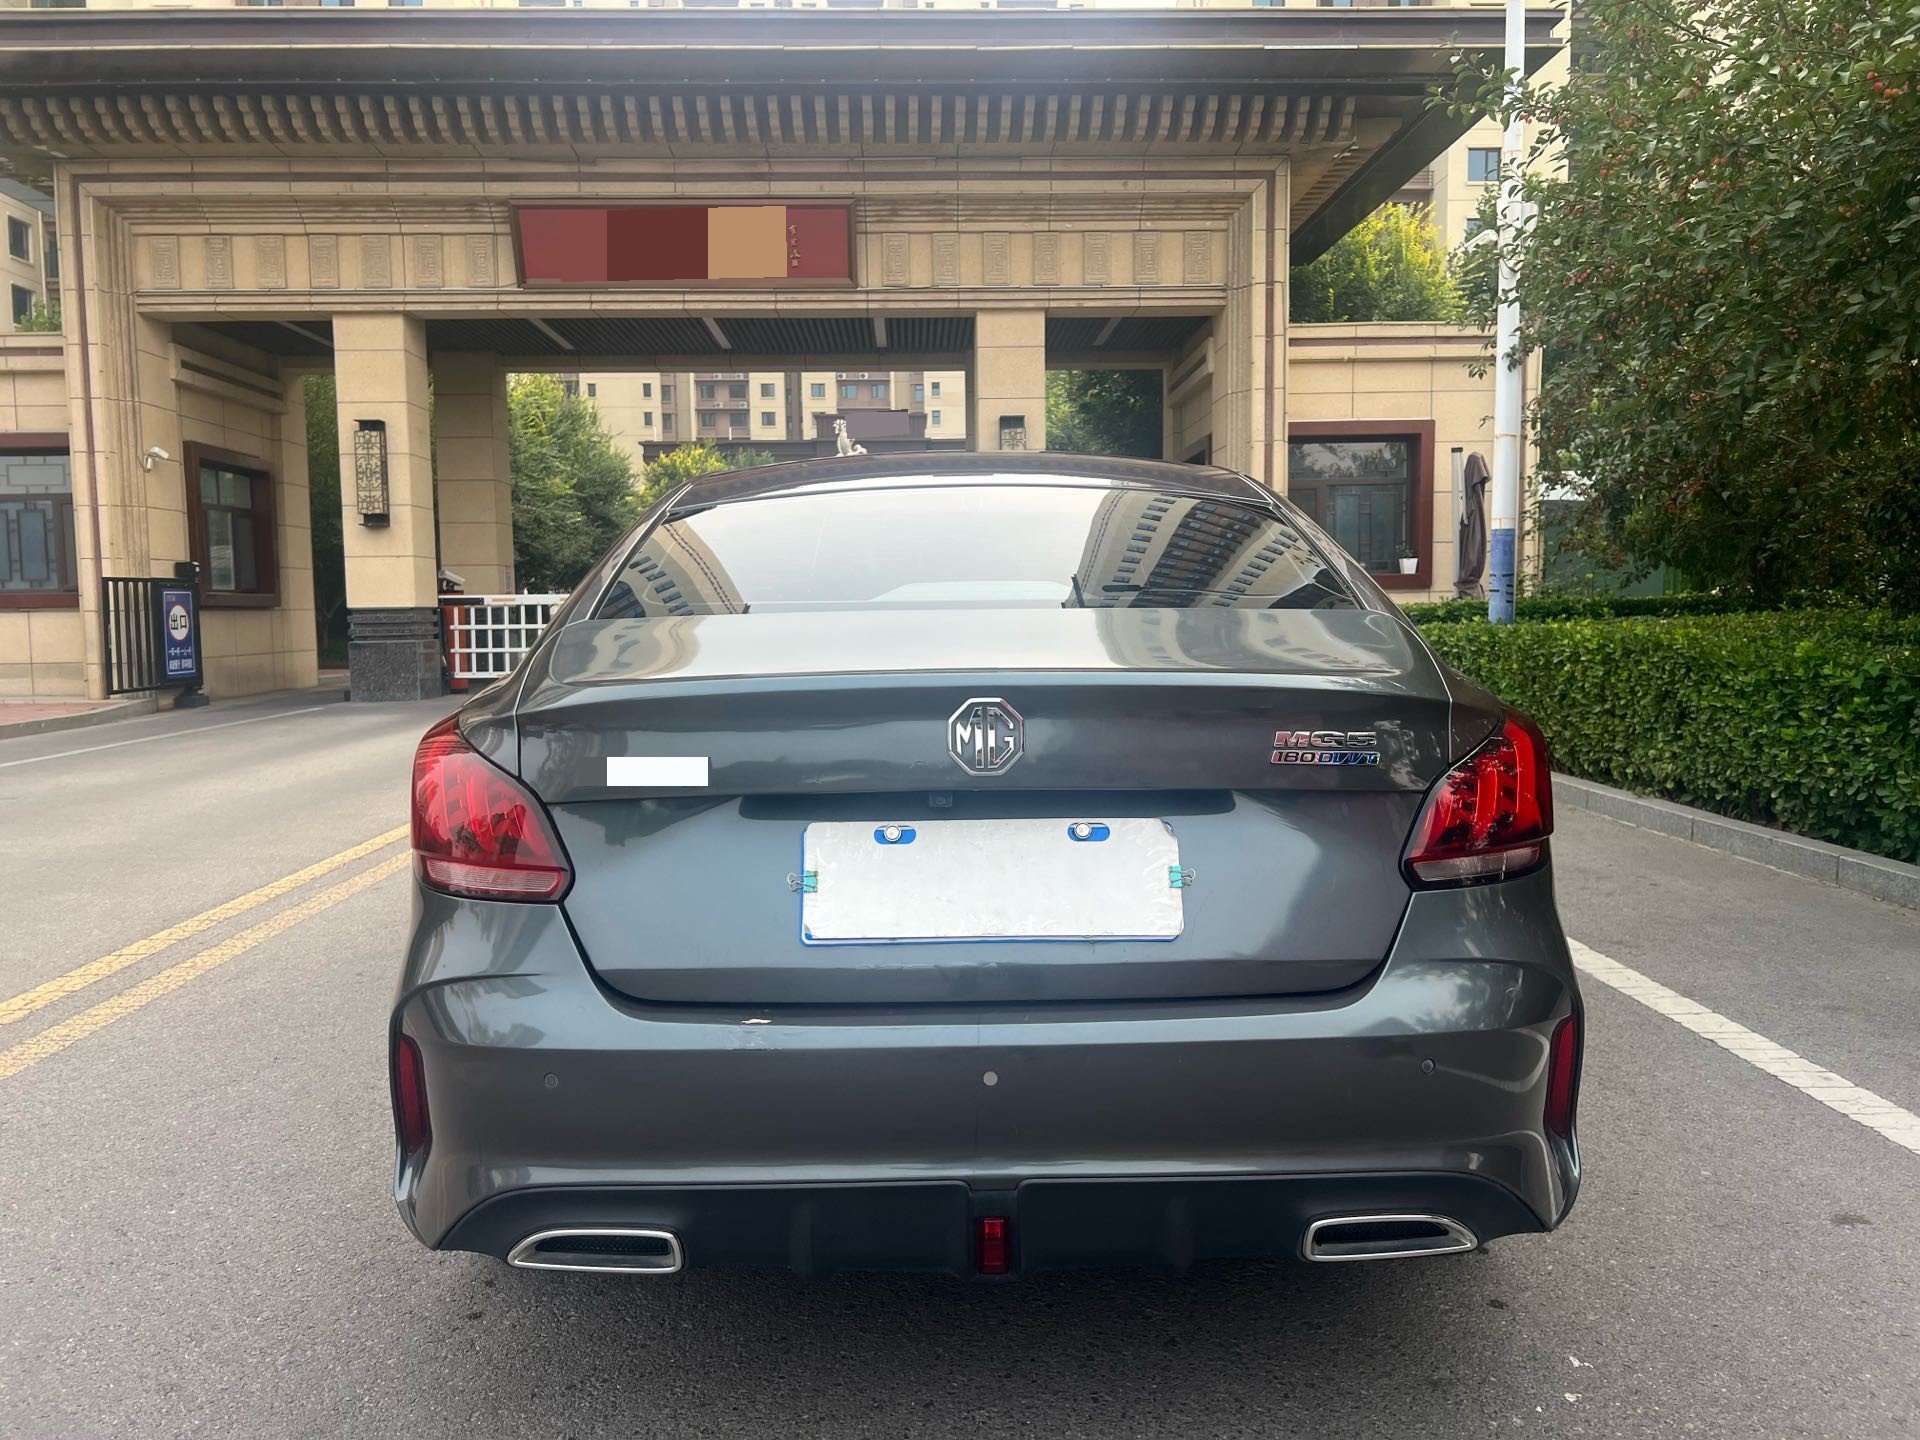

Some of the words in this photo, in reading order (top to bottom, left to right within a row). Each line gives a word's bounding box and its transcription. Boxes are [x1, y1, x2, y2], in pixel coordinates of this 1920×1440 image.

[170, 613, 188, 631] 出口
[955, 705, 1015, 769] MG
[1273, 730, 1378, 749] MG5
